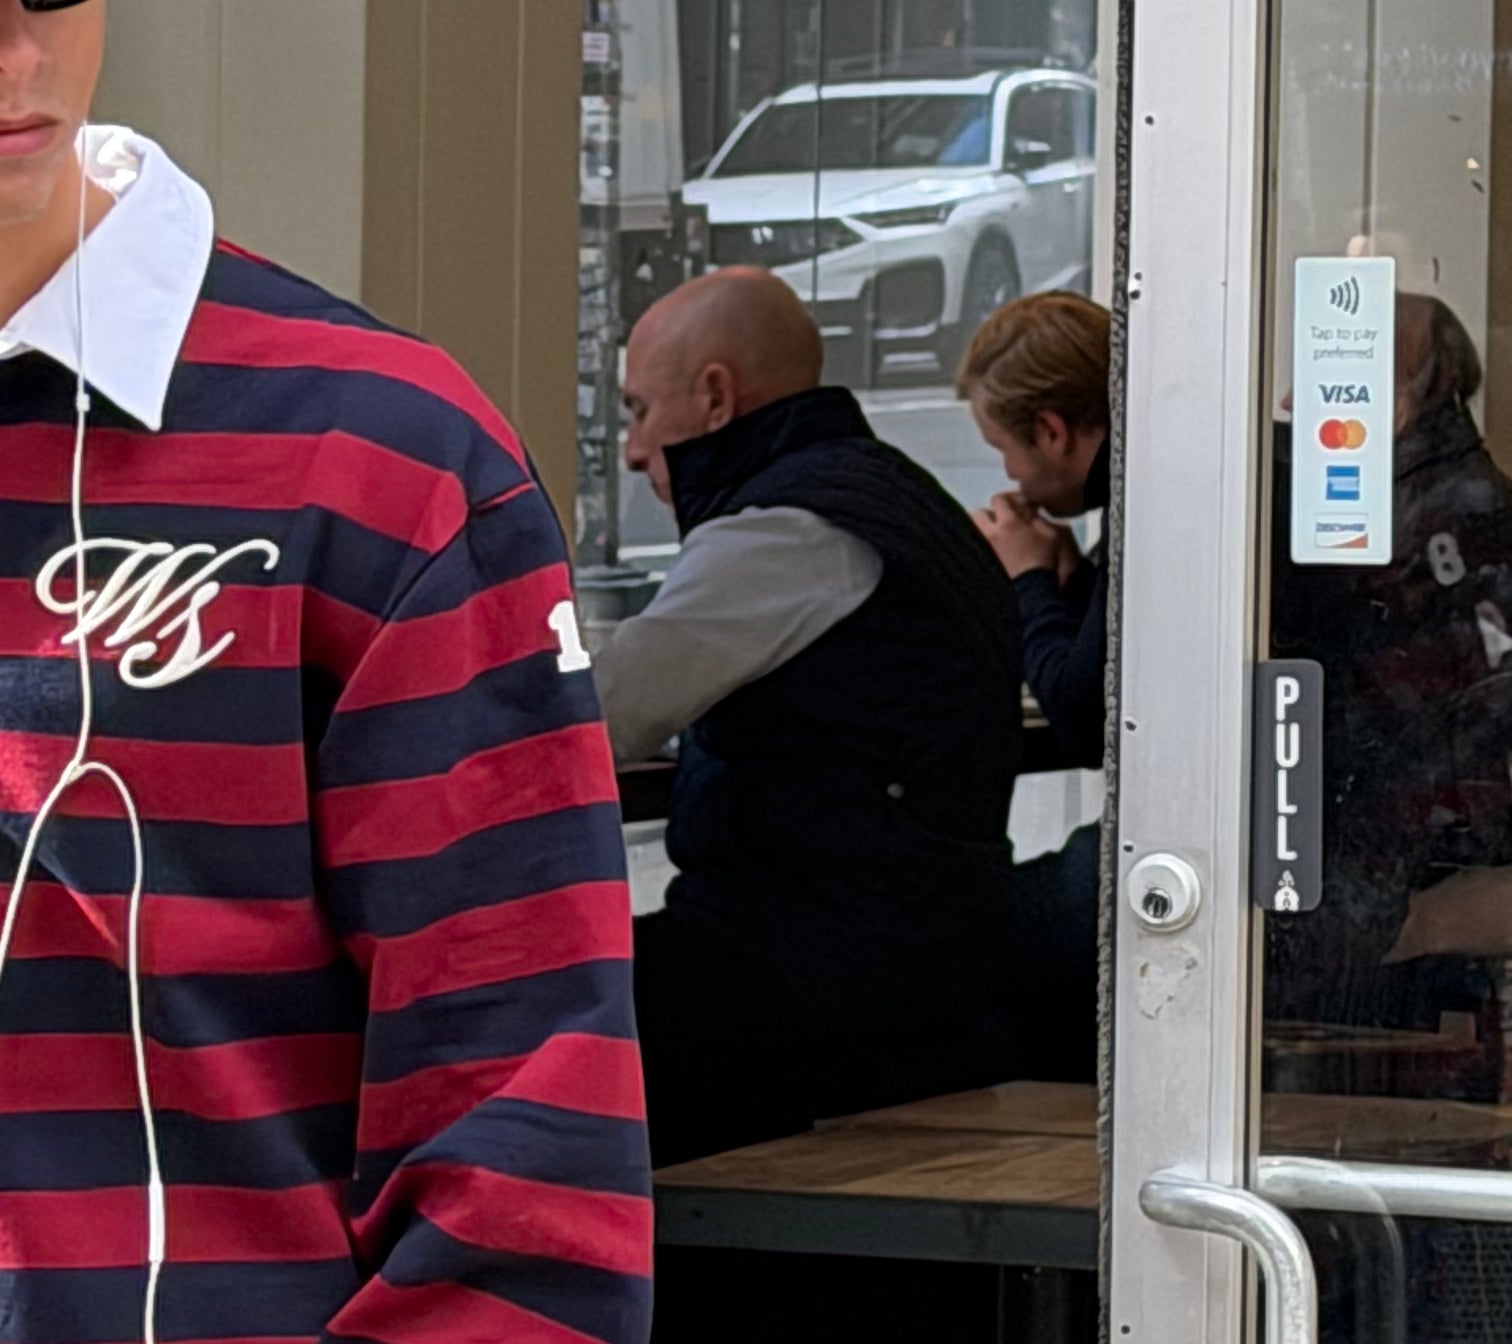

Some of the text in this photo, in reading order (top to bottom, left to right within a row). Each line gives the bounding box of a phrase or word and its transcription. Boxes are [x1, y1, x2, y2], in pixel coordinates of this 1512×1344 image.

[1337, 328, 1351, 341] to
[1318, 384, 1370, 404] VISA
[548, 600, 591, 673] 1
[1275, 676, 1300, 861] PULL
